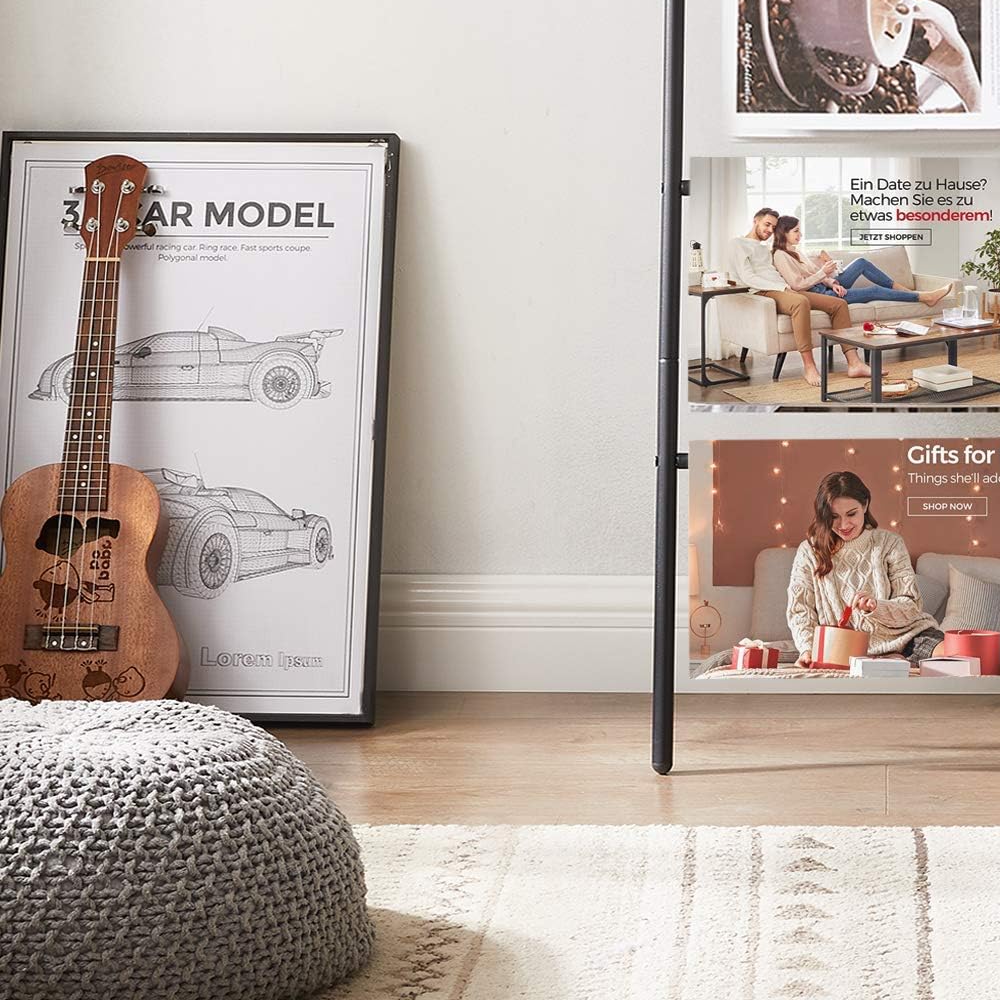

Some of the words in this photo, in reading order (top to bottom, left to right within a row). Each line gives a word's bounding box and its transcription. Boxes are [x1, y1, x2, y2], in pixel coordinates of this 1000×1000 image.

[850, 178, 873, 191] Ein
[877, 178, 912, 191] Date
[914, 180, 932, 191] zu
[936, 178, 988, 191] Hause?
[850, 193, 909, 206] Machen
[912, 193, 934, 206] Sie
[937, 196, 953, 206] es
[956, 196, 973, 206] zu
[137, 201, 193, 227] AR
[204, 201, 335, 228] MODEL
[850, 210, 893, 222] etwas
[896, 208, 993, 222] besonderem!
[859, 233, 883, 241] JETZT
[884, 233, 924, 241] SHOPPEN
[123, 243, 154, 252] owerful
[155, 243, 181, 254] racing
[199, 243, 218, 253] Ring
[241, 243, 257, 252] Fast
[258, 244, 283, 254] sports
[158, 253, 198, 263] Polygonal
[907, 444, 959, 464] Gifts
[963, 444, 996, 464] for
[908, 473, 948, 486] Things
[950, 472, 980, 484] she'll
[922, 503, 948, 511] SHOP
[949, 503, 973, 511] NOW
[200, 646, 273, 668] Lorem
[278, 651, 324, 671] Ipsum
